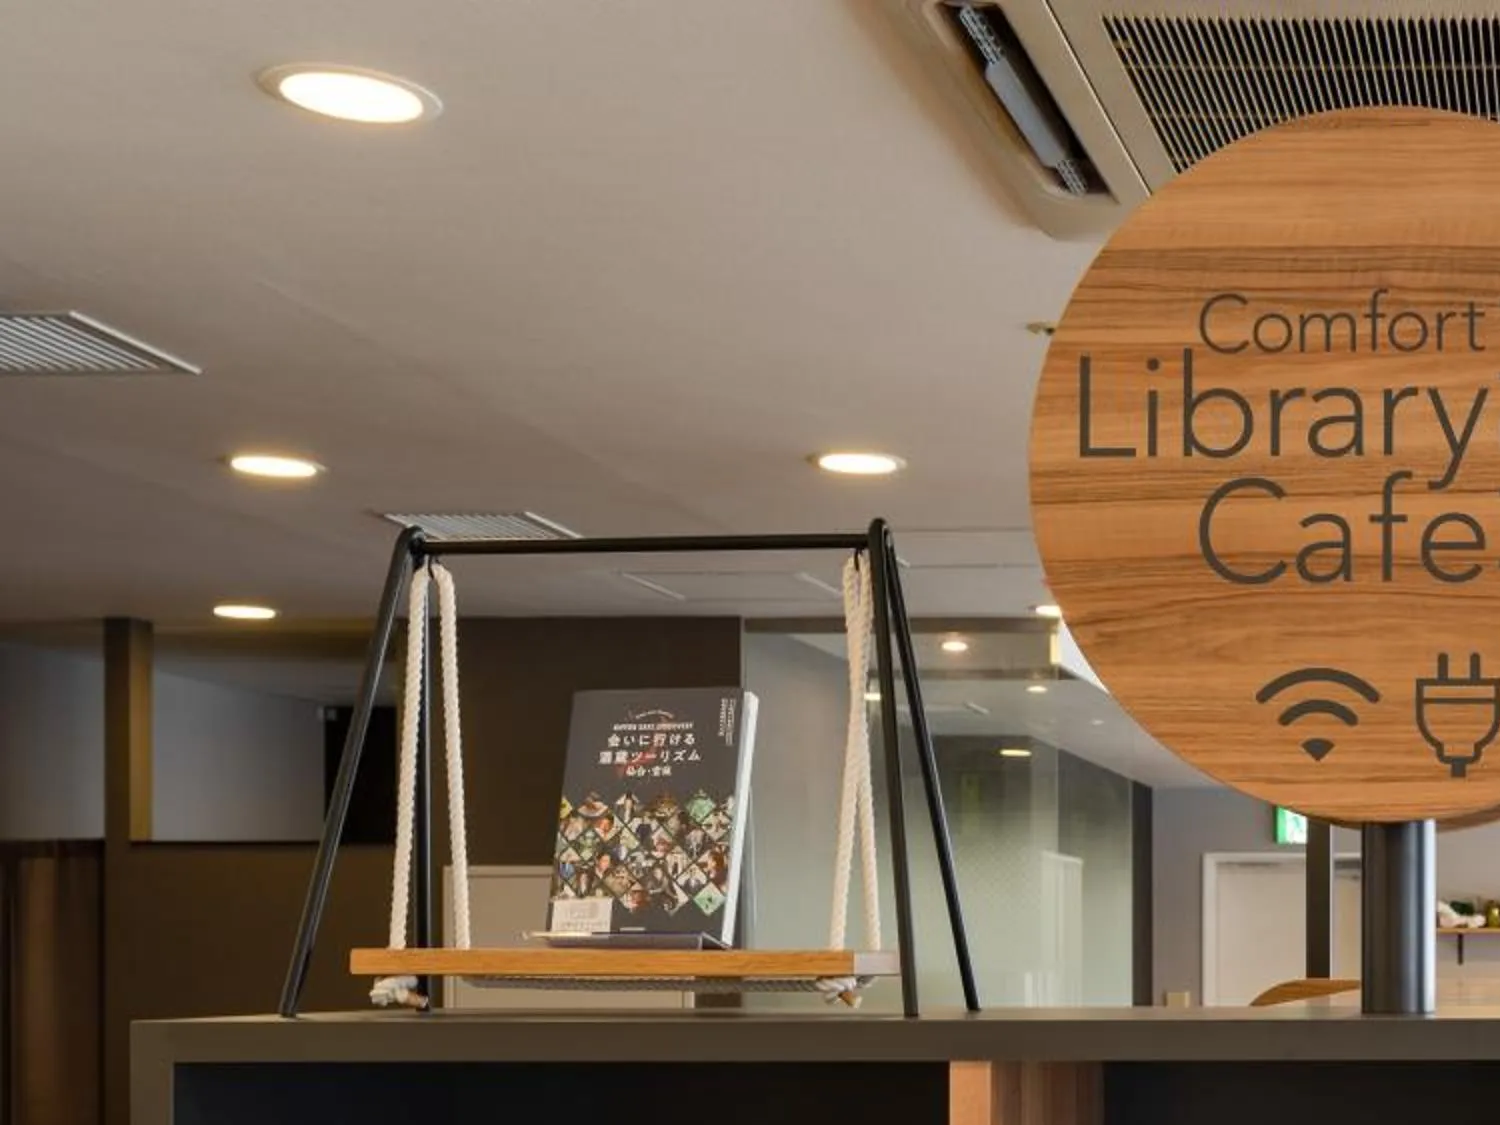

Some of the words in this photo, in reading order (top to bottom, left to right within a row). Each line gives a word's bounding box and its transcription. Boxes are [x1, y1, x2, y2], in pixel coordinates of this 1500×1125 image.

[1200, 289, 1487, 353] Comfort
[1079, 347, 1489, 490] Library
[1200, 470, 1487, 585] Cafe
[607, 733, 695, 747] 会いに行ける
